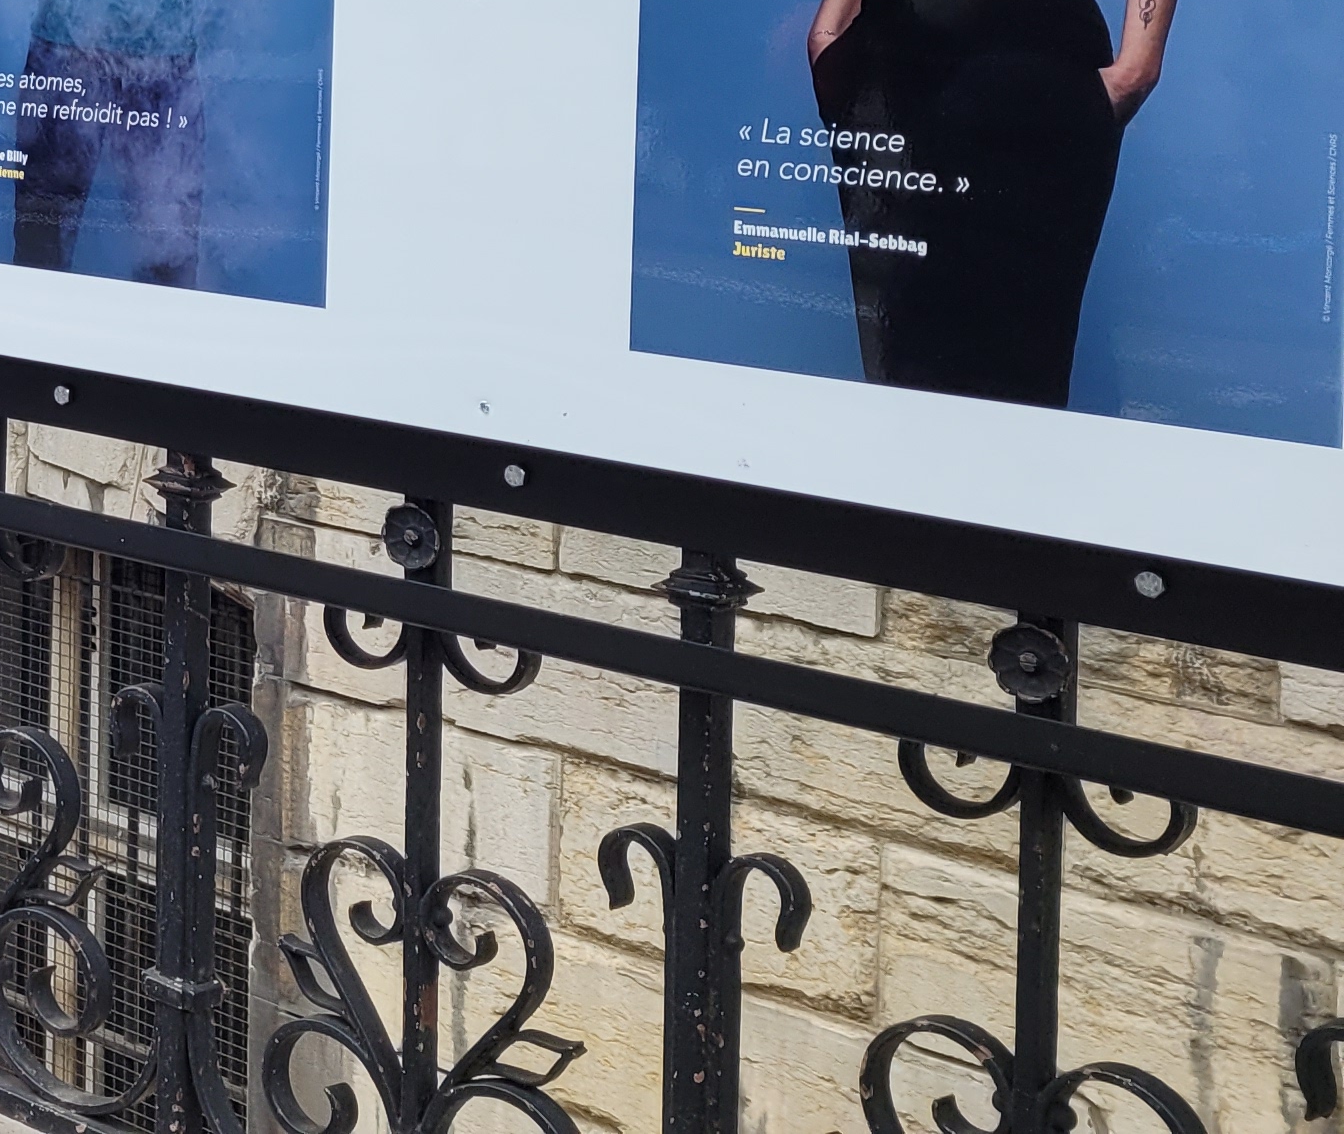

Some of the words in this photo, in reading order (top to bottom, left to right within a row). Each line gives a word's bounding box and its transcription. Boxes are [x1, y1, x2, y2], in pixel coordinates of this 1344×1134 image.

[19, 72, 87, 97] atomes,
[21, 102, 48, 118] me
[53, 98, 123, 125] refroidit
[126, 111, 160, 131] pas
[761, 117, 791, 145] La
[799, 122, 906, 153] science
[6, 148, 29, 166] Billy
[737, 157, 770, 179] en
[778, 160, 943, 193] conscience.
[733, 219, 826, 243] Emmanuelle
[732, 241, 786, 261] Juriste
